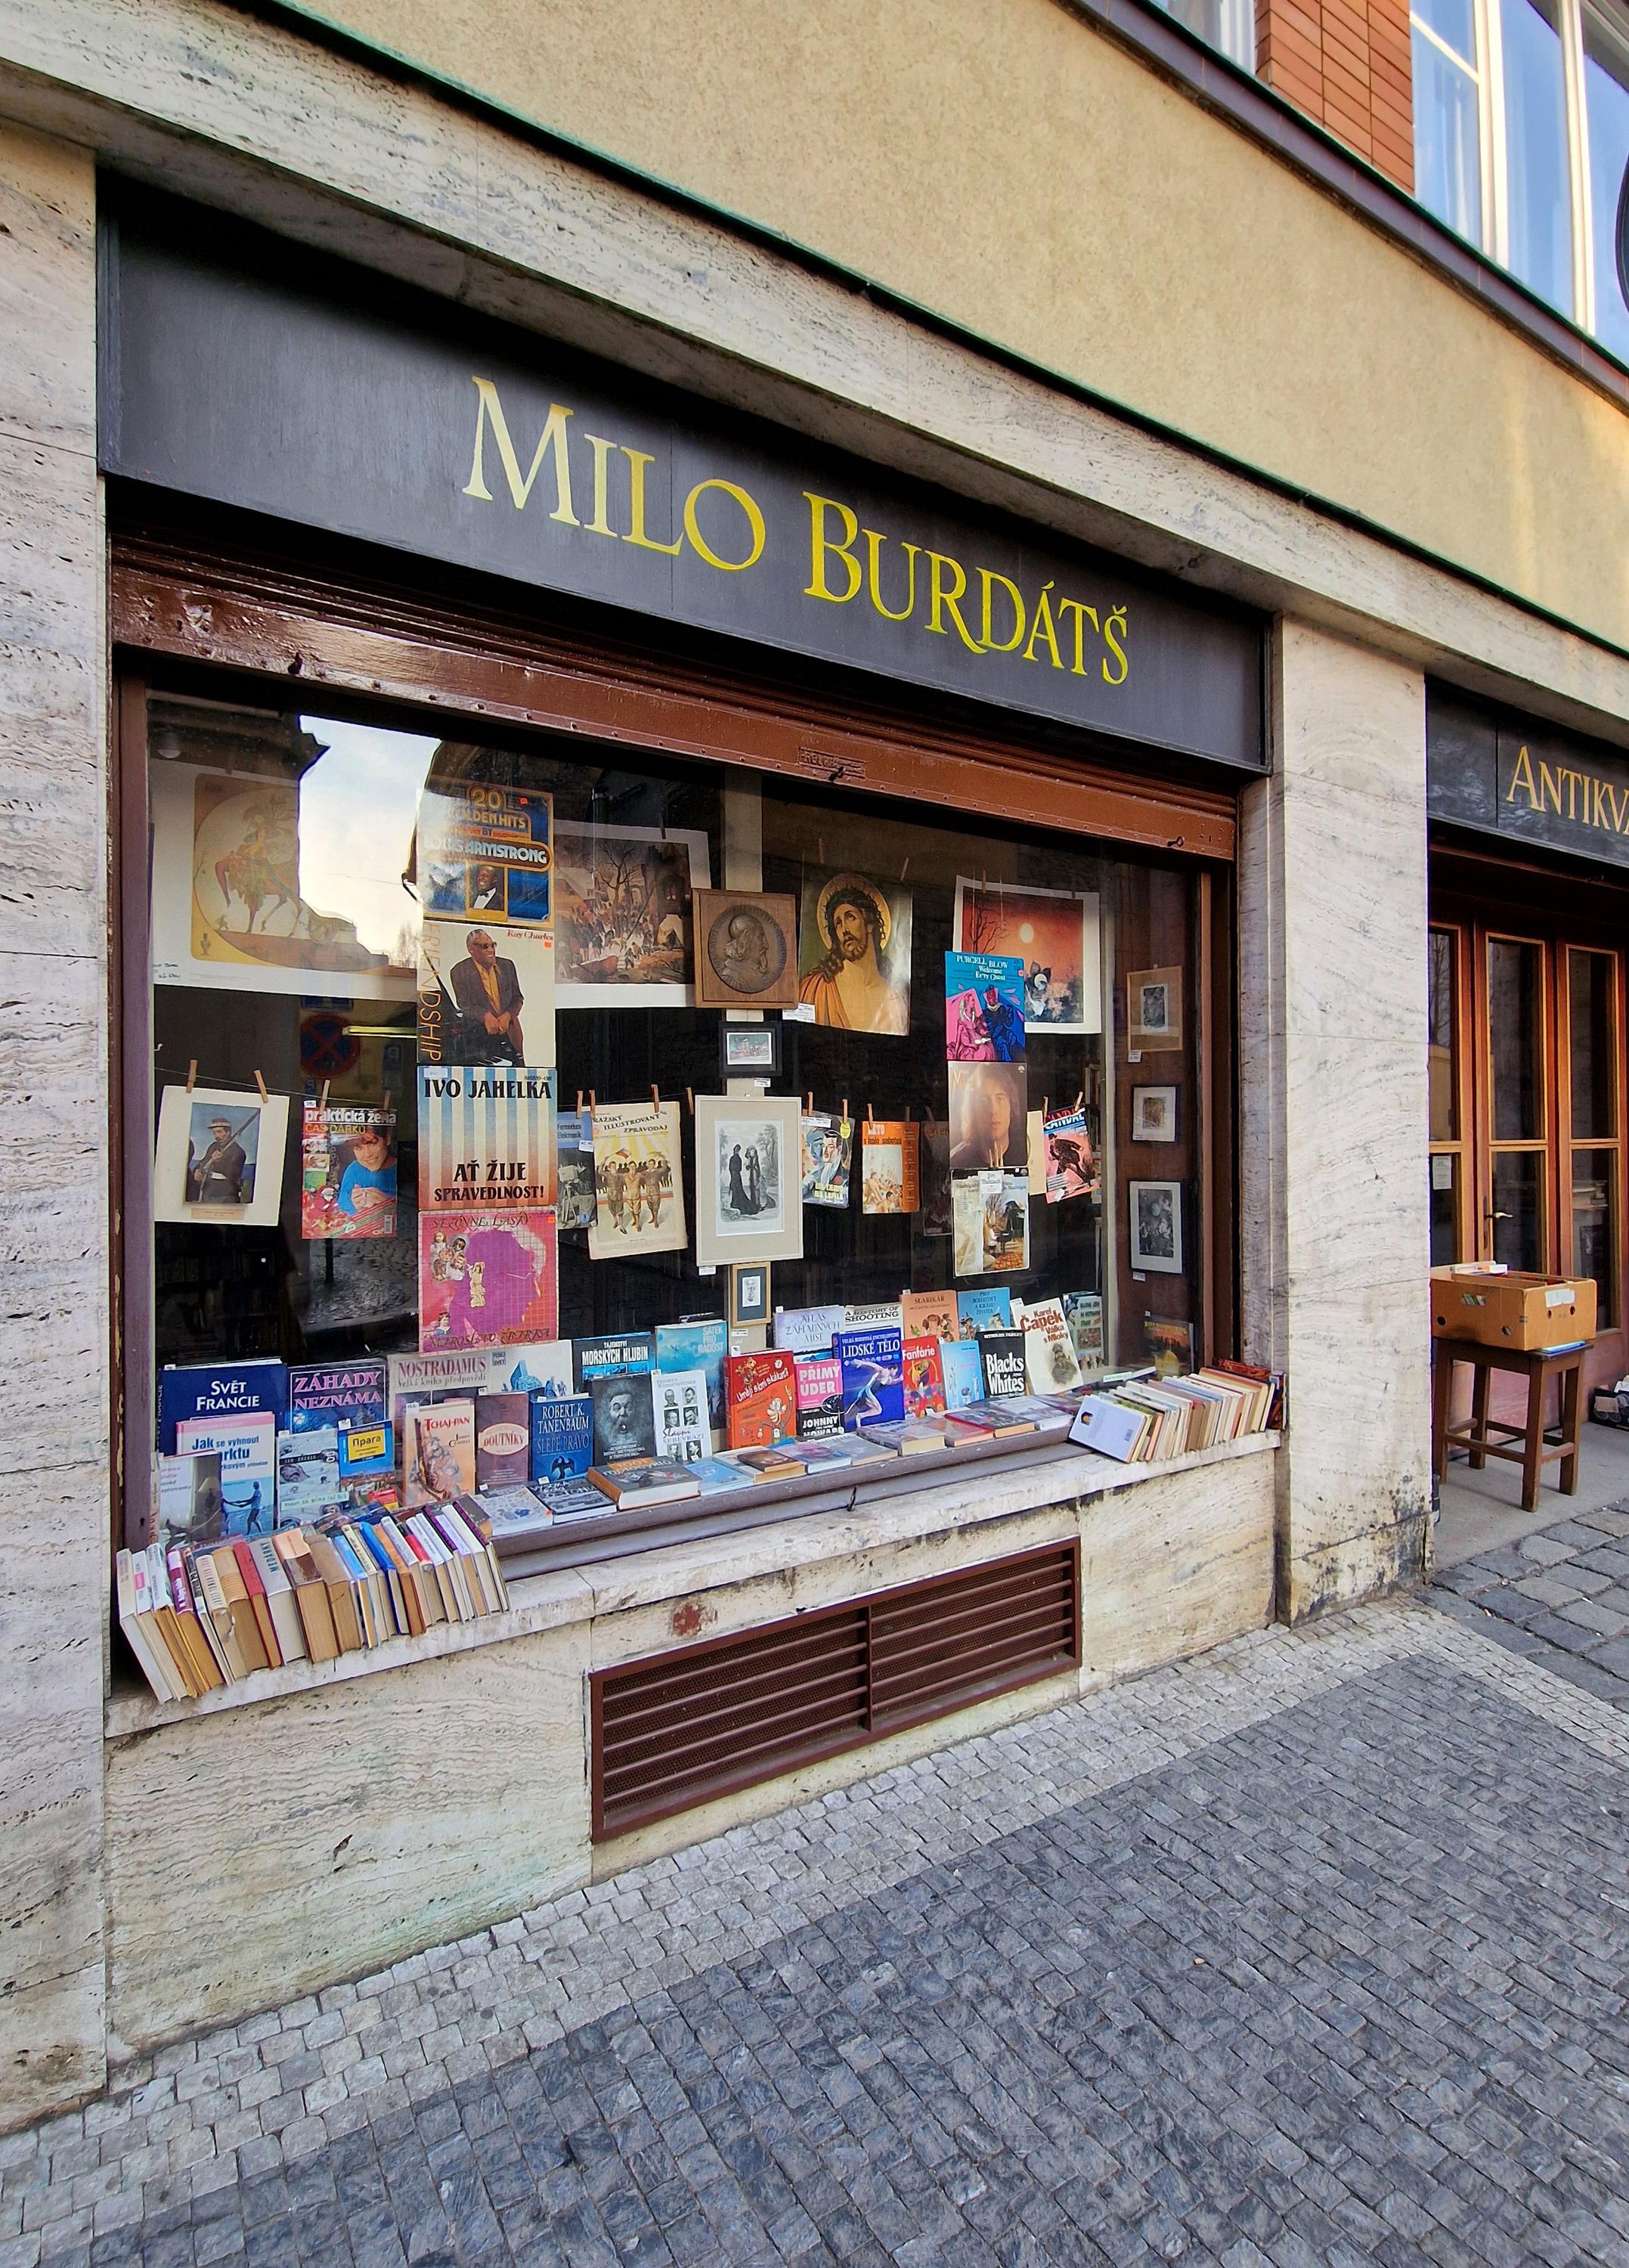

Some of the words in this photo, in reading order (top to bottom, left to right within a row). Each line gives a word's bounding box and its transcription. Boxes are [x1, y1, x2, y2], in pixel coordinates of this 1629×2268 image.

[462, 375, 766, 571] MILO
[802, 490, 1129, 686] BURDÁTŠ
[470, 786, 502, 810] 20
[499, 816, 526, 829] HITS
[465, 840, 548, 864] ARMSTRONG
[956, 955, 987, 965] PURCELL
[424, 1079, 461, 1098] IVO
[468, 1080, 552, 1099] JAHELKA
[453, 1159, 479, 1182] AŤ
[486, 1159, 527, 1182] ŽIJE
[434, 1185, 544, 1202] SPRAVEDLNOST!
[844, 1311, 900, 1323] SHOOTING
[1020, 1310, 1064, 1332] Čapek
[581, 1346, 621, 1366] MOŘSKÝCH
[623, 1346, 649, 1362] HLUBIN
[842, 1342, 875, 1359] LIDSKÉ
[877, 1338, 900, 1353] TĚLO
[902, 1344, 936, 1361] Fanfárie
[398, 1356, 487, 1379] NOSTRADAMUS
[798, 1362, 841, 1383] PŘÍMÝ
[985, 1351, 1025, 1374] Blacks
[210, 1380, 247, 1396] SVĚT
[294, 1371, 382, 1393] ZÁHADY
[800, 1380, 836, 1397] ÚDER
[987, 1373, 1025, 1396] Whites
[196, 1396, 260, 1411] FRANCIE
[294, 1390, 382, 1411] NEZNÁMA
[542, 1402, 575, 1420] ROBERT
[577, 1402, 586, 1417] K.
[424, 1415, 470, 1432] TCHAJ-PAN
[537, 1415, 590, 1435] TANENBAUM
[802, 1415, 838, 1429] JOHNNY
[192, 1436, 214, 1451] Jak
[228, 1436, 259, 1447] vyhnout
[352, 1435, 381, 1448] Прага
[483, 1431, 525, 1447] DOUTNÍKY
[537, 1435, 560, 1454] SLEPÉ
[562, 1433, 590, 1451] PRÁVO
